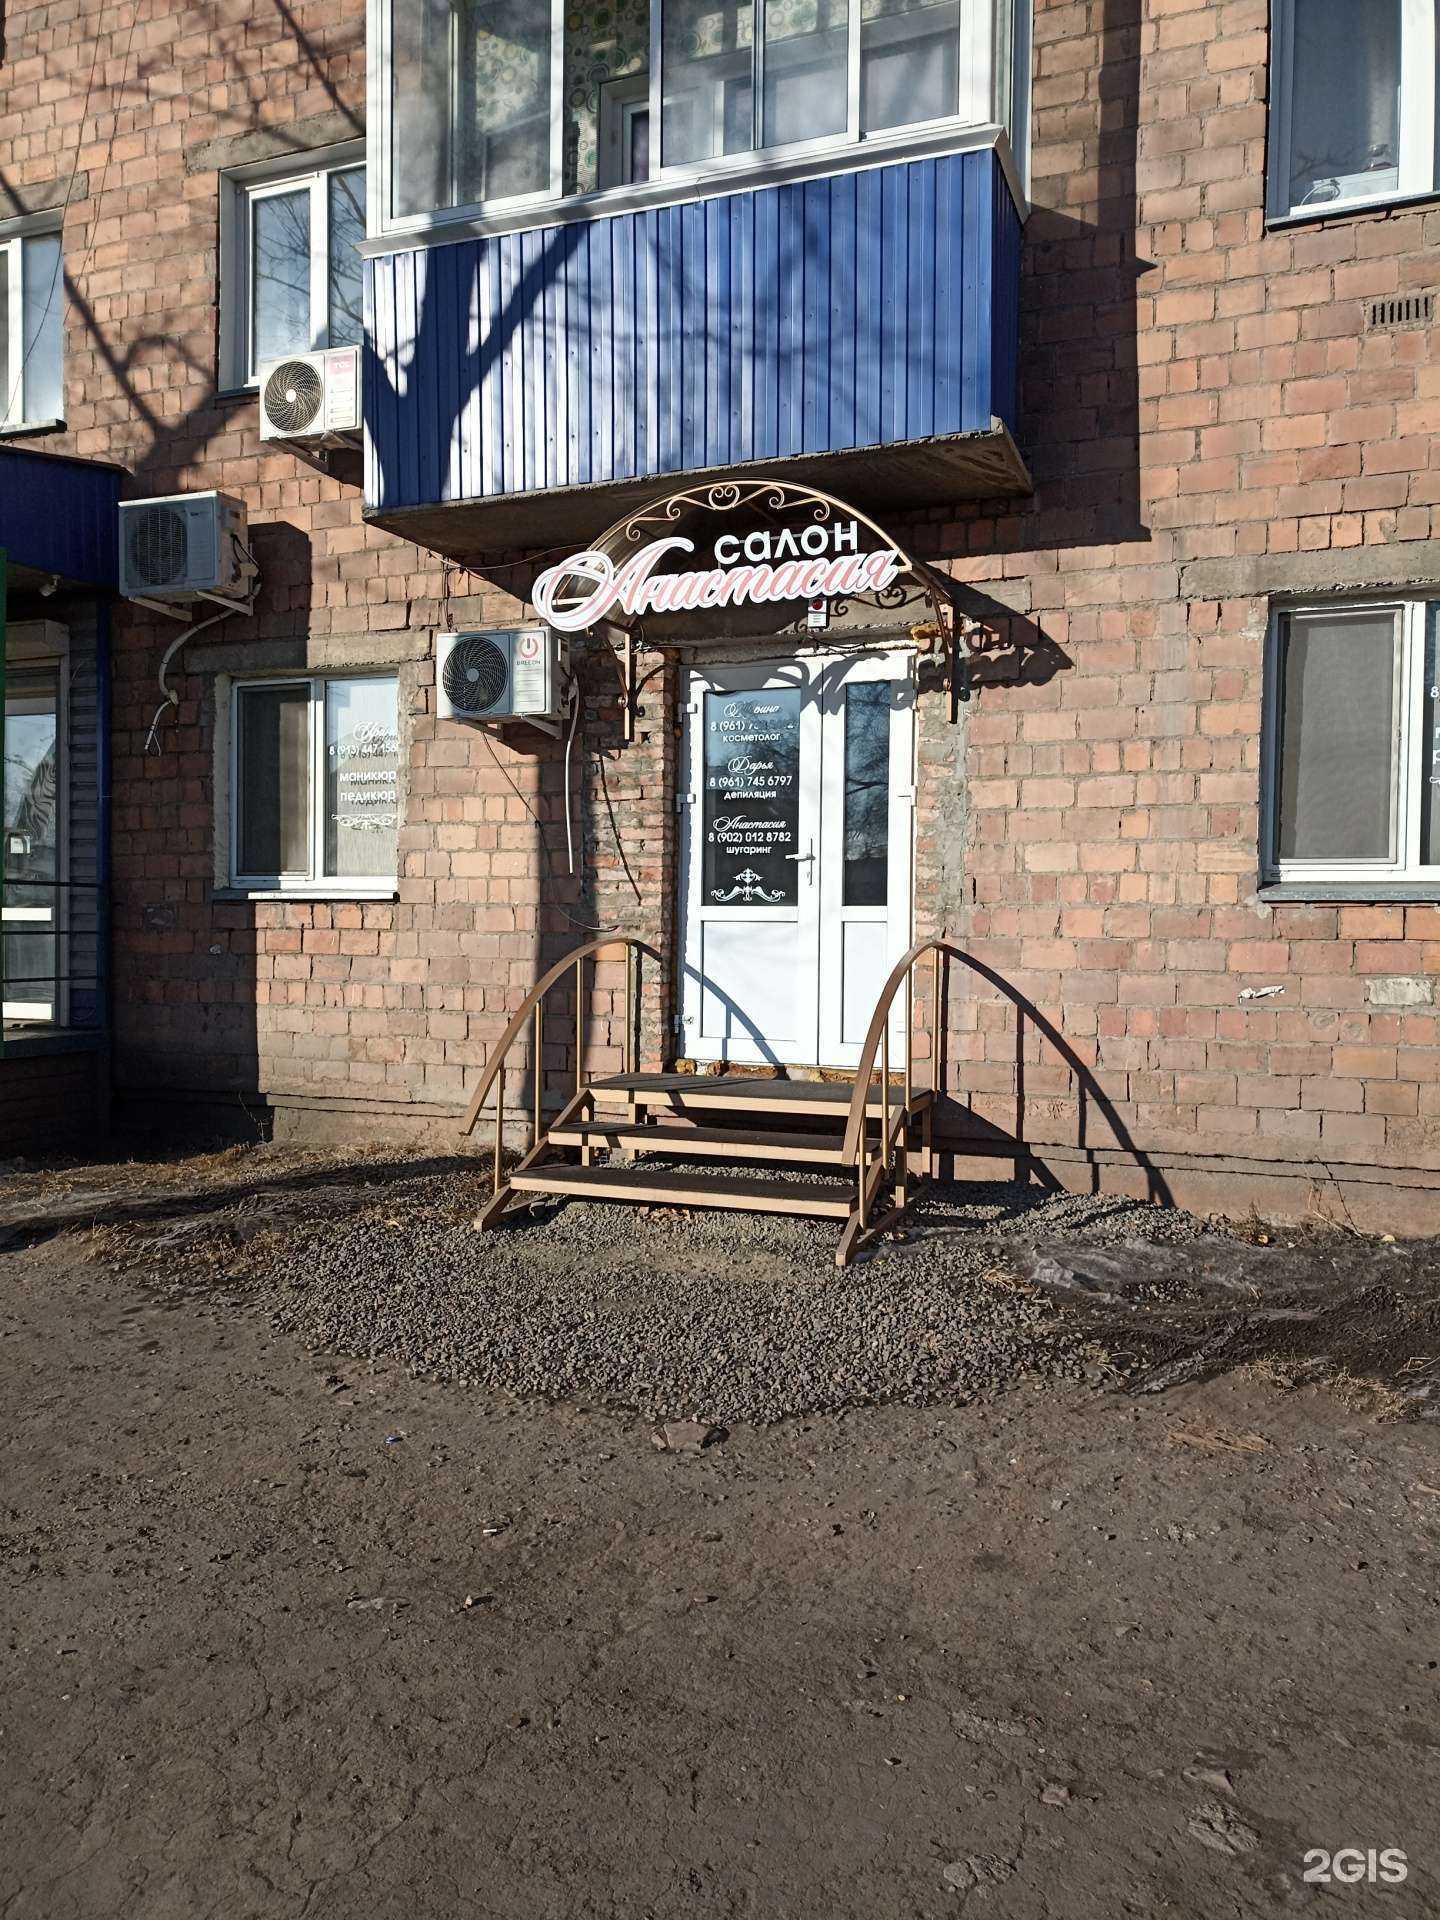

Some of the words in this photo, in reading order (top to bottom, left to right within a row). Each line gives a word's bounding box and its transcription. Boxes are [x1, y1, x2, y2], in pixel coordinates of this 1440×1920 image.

[714, 521, 858, 565] салон
[532, 537, 907, 632] Анастасия
[710, 721, 717, 731] 8
[719, 720, 745, 732] (961)
[723, 733, 781, 743] косметолог
[329, 745, 335, 756] 8
[728, 755, 774, 775] Дарья
[339, 770, 397, 782] маникюр
[709, 777, 716, 787] 8
[718, 776, 744, 788] (961)
[747, 776, 765, 786] 745
[767, 775, 793, 786] 6797
[340, 790, 396, 802] педикюр
[723, 790, 777, 800] депиляция
[712, 815, 787, 832] Анастасия
[708, 832, 715, 842] 8
[717, 832, 743, 843] (902)
[745, 832, 764, 842] 012
[766, 831, 792, 842] 8782
[726, 846, 773, 855] шугаринг
